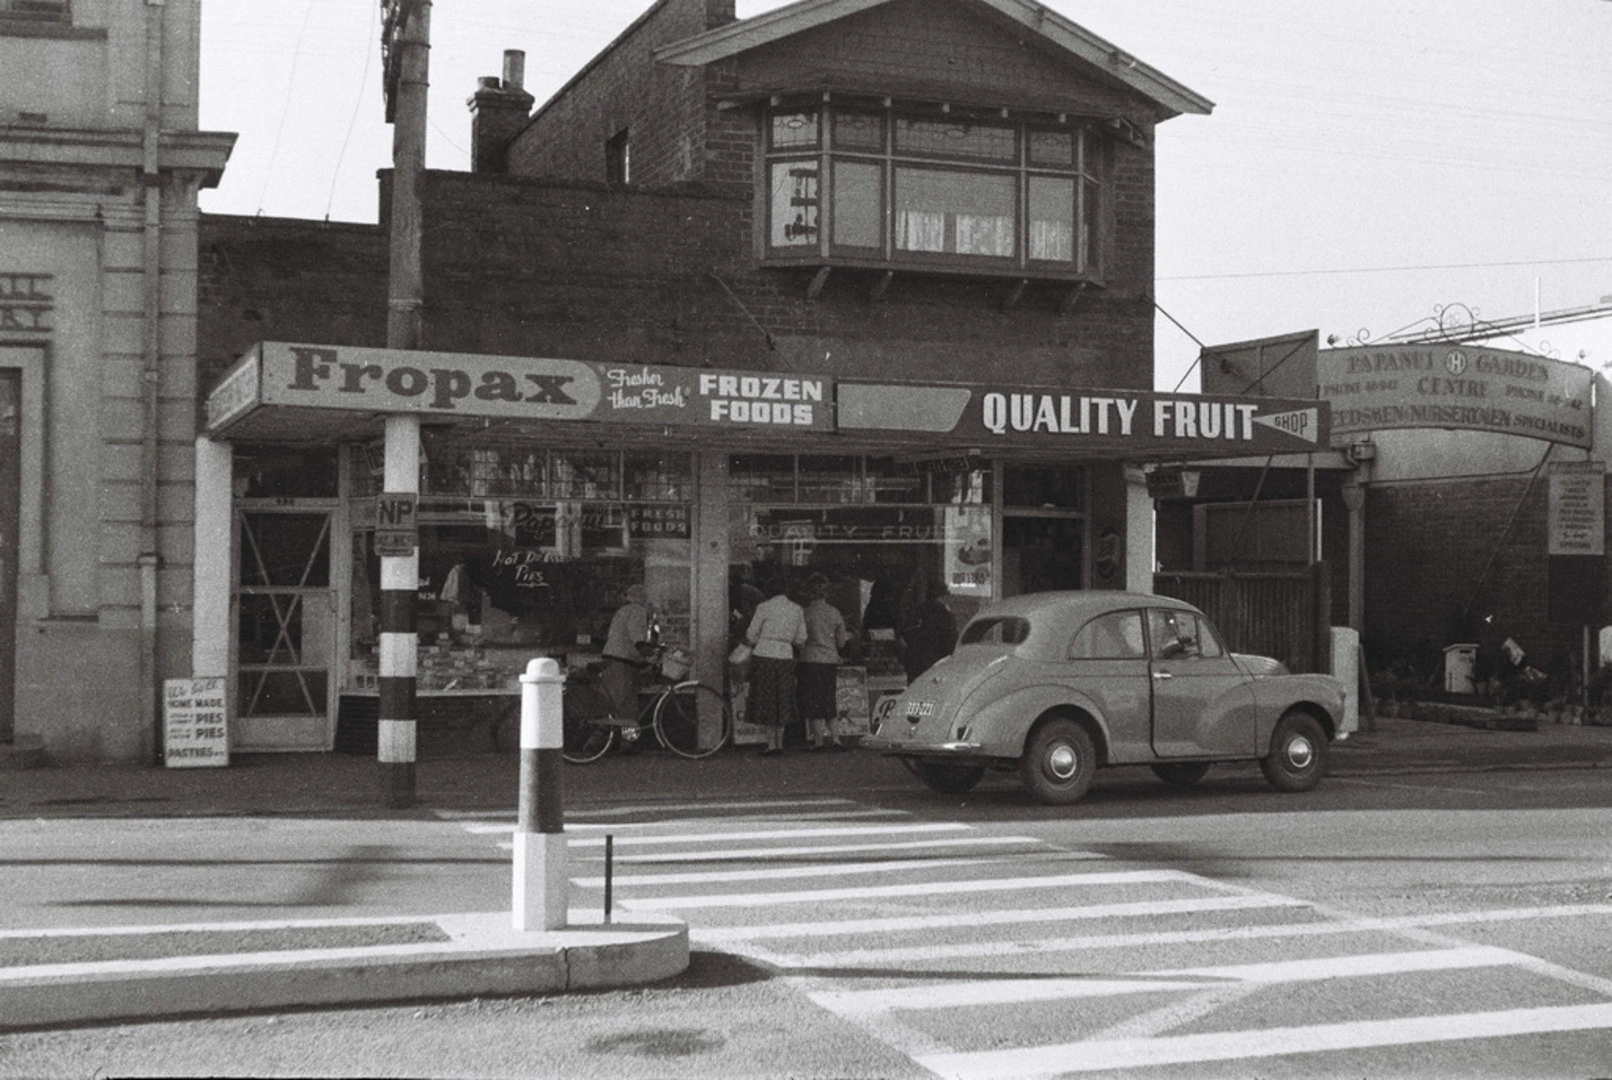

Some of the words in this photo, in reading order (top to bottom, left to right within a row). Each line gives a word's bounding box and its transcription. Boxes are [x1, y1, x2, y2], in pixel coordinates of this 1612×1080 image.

[1347, 350, 1434, 374] PAPANUI
[1475, 353, 1549, 381] GARDEN
[288, 347, 577, 409] Fropax
[700, 373, 823, 401] FROZEN
[1323, 380, 1361, 397] PHONE
[1416, 376, 1489, 397] CENTRE
[607, 388, 643, 410] than
[710, 400, 814, 425] FOODS
[983, 393, 1138, 435] QUALITY
[1154, 400, 1258, 440] FRUIT
[1273, 412, 1308, 433] SHOP
[1330, 405, 1404, 427] EEDSMEN
[379, 500, 413, 525] NP
[195, 698, 224, 708] MADE
[196, 712, 224, 724] PIES
[196, 727, 225, 739] PIES
[167, 747, 214, 759] PASTIES
